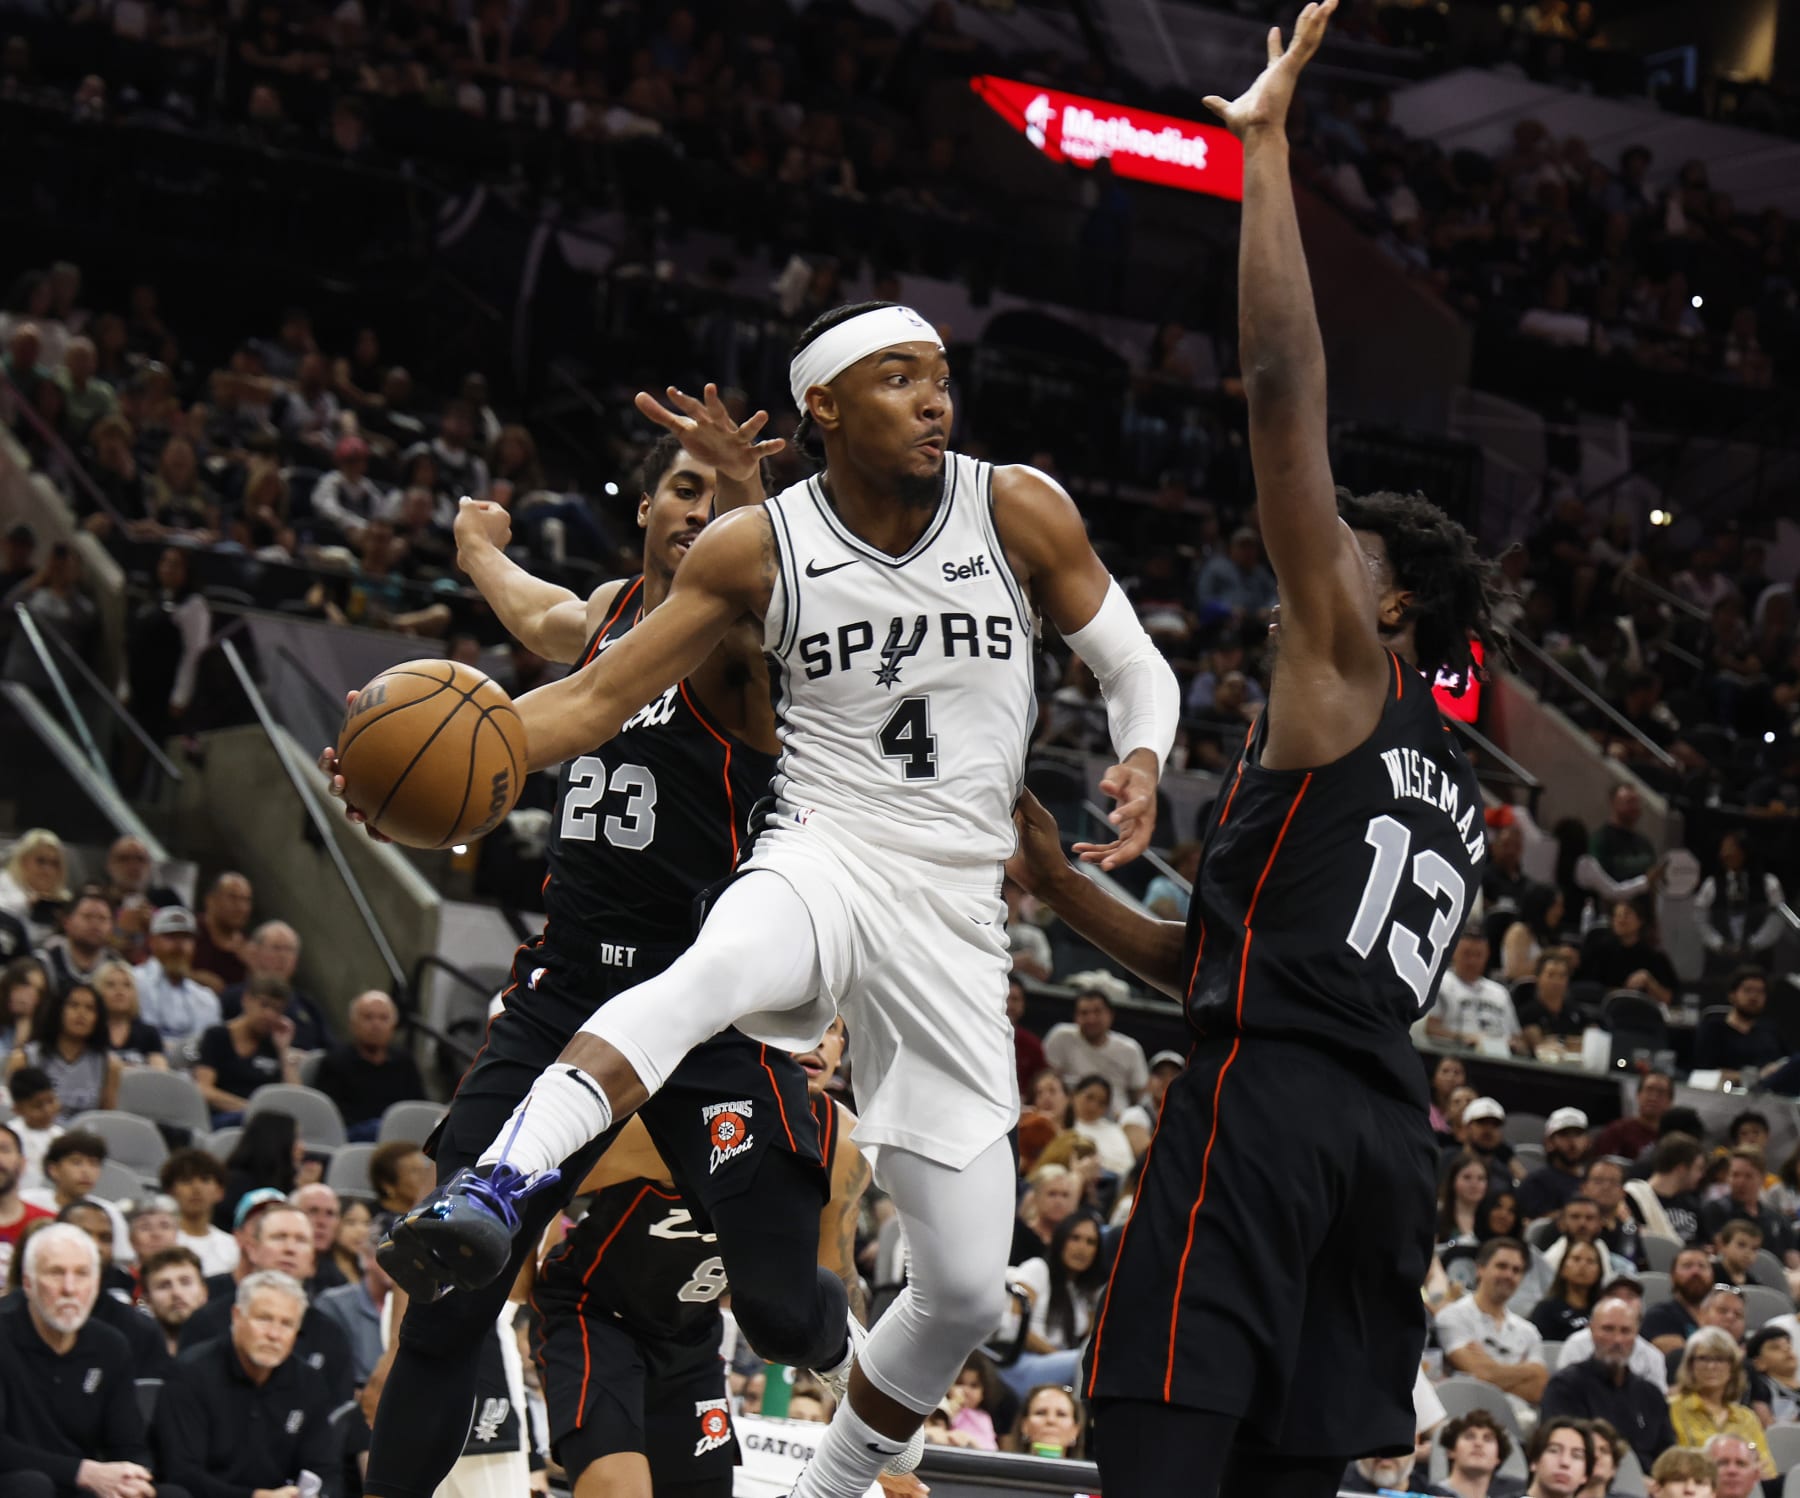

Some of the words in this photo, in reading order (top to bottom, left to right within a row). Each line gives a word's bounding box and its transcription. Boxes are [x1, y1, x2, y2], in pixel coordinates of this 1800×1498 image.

[941, 555, 990, 582] Self.
[798, 613, 1013, 691] SPURS
[876, 694, 940, 783] 4
[559, 755, 658, 851] 23
[1380, 747, 1485, 866] WISEMAN
[1346, 814, 1466, 1009] 13
[600, 943, 637, 968] DET
[701, 1100, 753, 1126] PISTONS
[709, 1134, 754, 1175] Detroit
[745, 1434, 816, 1462] GATOR
